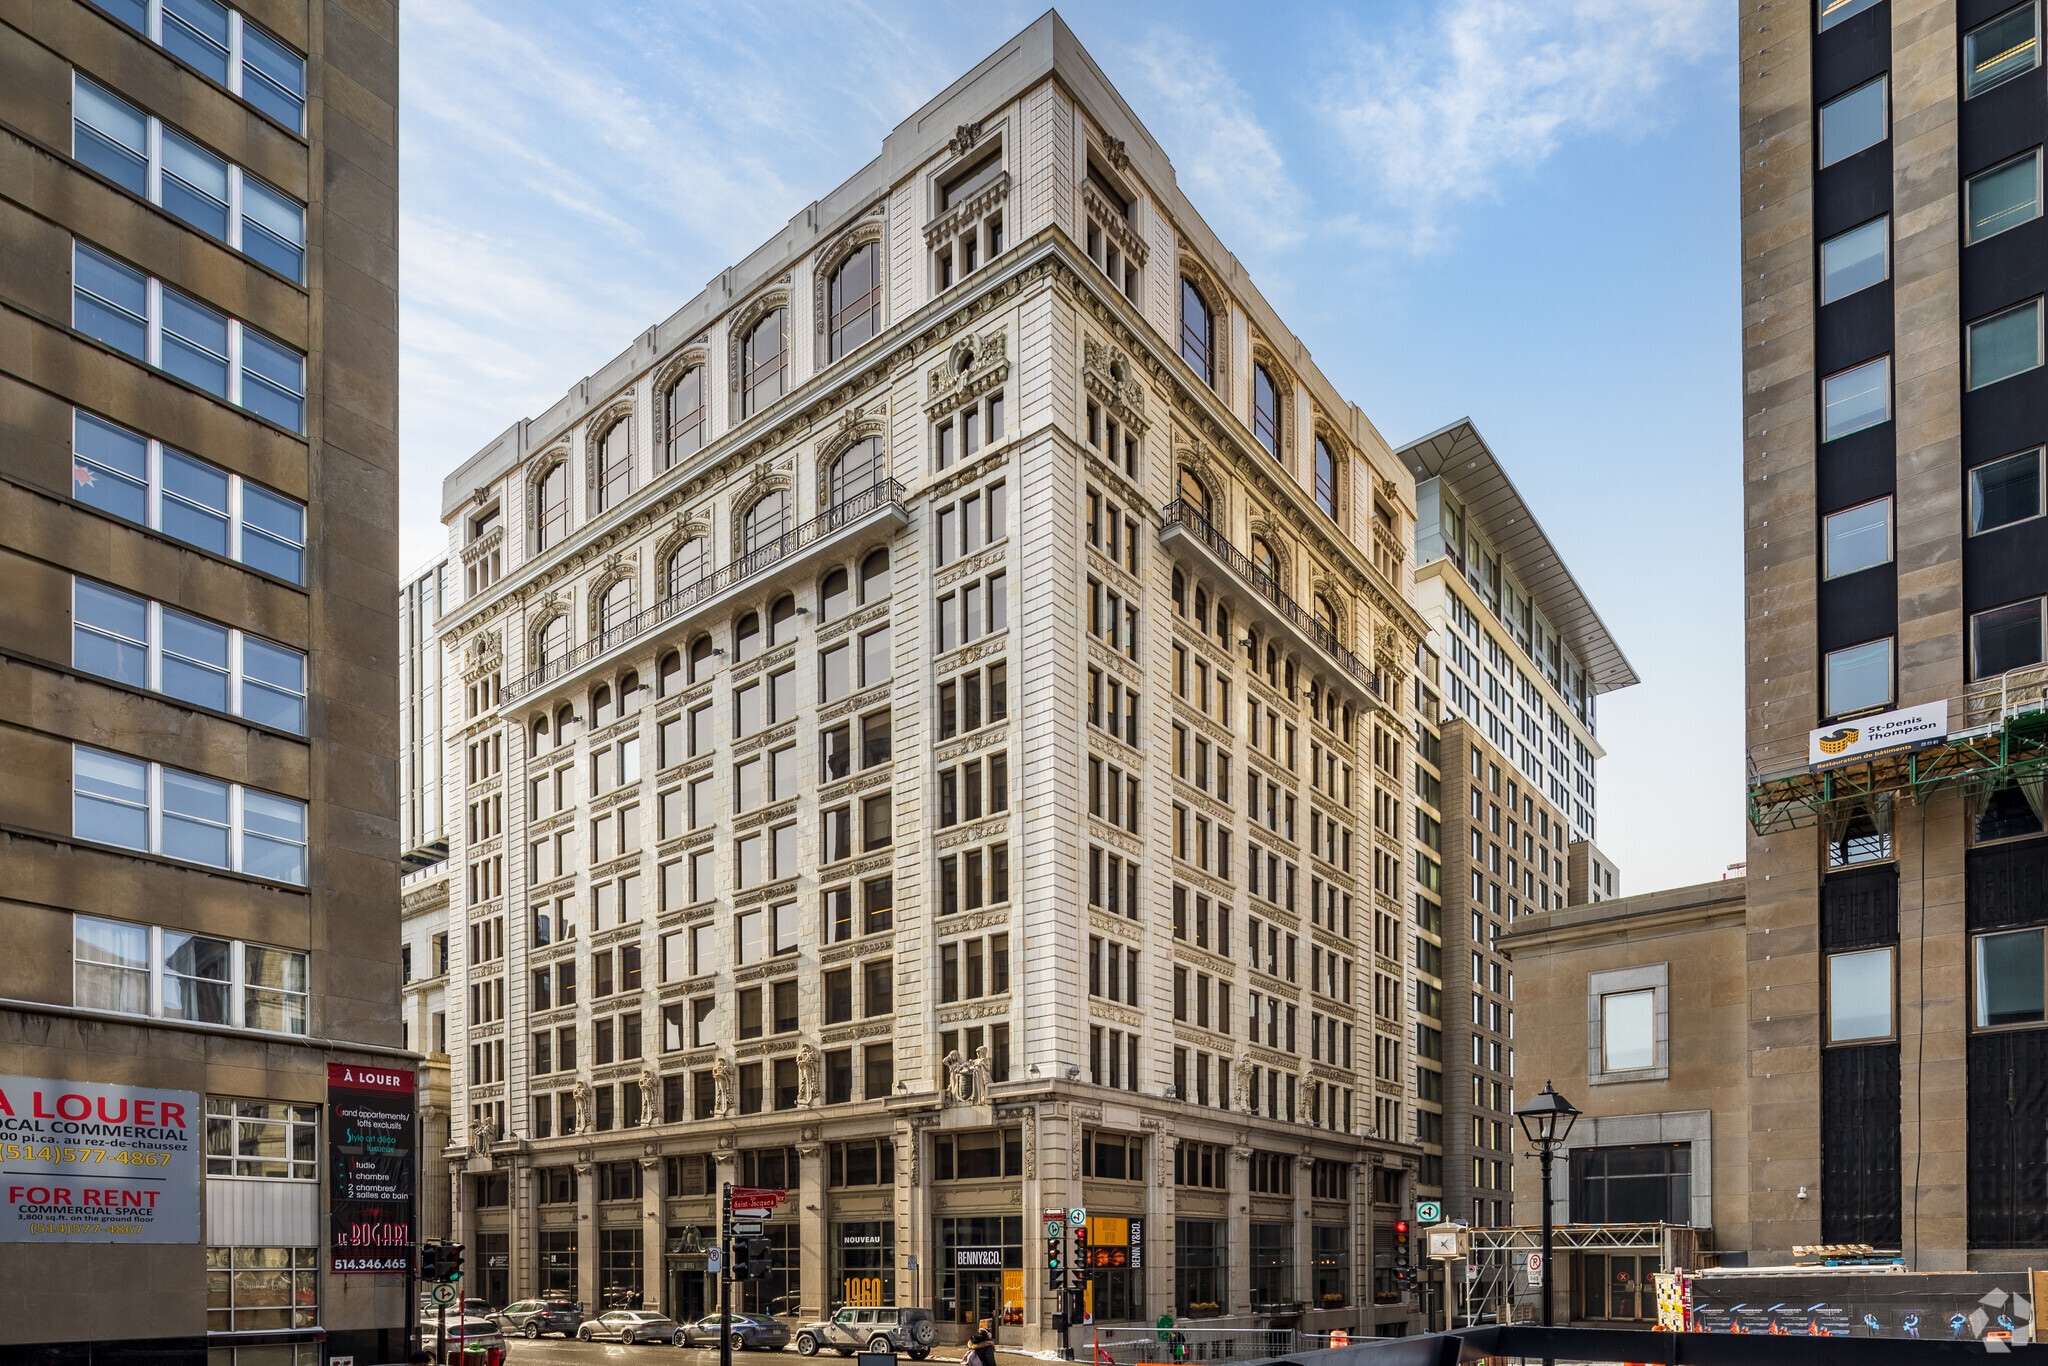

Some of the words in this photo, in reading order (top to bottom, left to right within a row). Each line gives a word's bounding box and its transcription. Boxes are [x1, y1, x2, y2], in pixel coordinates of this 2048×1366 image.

[1868, 717, 1922, 734] St-Denis
[1868, 722, 1937, 741] Thompson
[1817, 755, 1862, 769] Restauration
[1874, 744, 1912, 757] bâtiments
[344, 1068, 353, 1082] À
[359, 1072, 400, 1086] LOUER
[33, 1091, 187, 1128] LOUER
[335, 1103, 358, 1118] Grand
[358, 1110, 410, 1121] appartements/
[0, 1118, 45, 1132] CAL
[51, 1121, 188, 1141] COMMERCIAL
[357, 1120, 372, 1128] lofts
[373, 1121, 402, 1130] exclusifs
[22, 1133, 60, 1144] pi.ca.
[64, 1137, 81, 1145] au
[85, 1138, 188, 1151] rez-de-chaussez
[346, 1127, 364, 1143] Style
[365, 1134, 376, 1143] art
[0, 1143, 172, 1167] (514)577-4867
[351, 1155, 376, 1170] Studio
[348, 1171, 353, 1179] 1
[348, 1183, 354, 1191] 2
[355, 1184, 397, 1192] chambres/
[356, 1191, 379, 1199] salles
[9, 1186, 73, 1206] FOR
[83, 1188, 161, 1208] RENT
[733, 1200, 774, 1209] Saint-Jacques
[17, 1214, 43, 1222] 3,800
[101, 1215, 132, 1223] ground
[19, 1204, 112, 1215] COMMERCIAL
[115, 1207, 153, 1216] SPACE
[30, 1222, 144, 1235] (514)577-4867
[350, 1222, 408, 1247] BOGART
[957, 1251, 1002, 1265] BENNY&CO.
[843, 1277, 882, 1307] 1960
